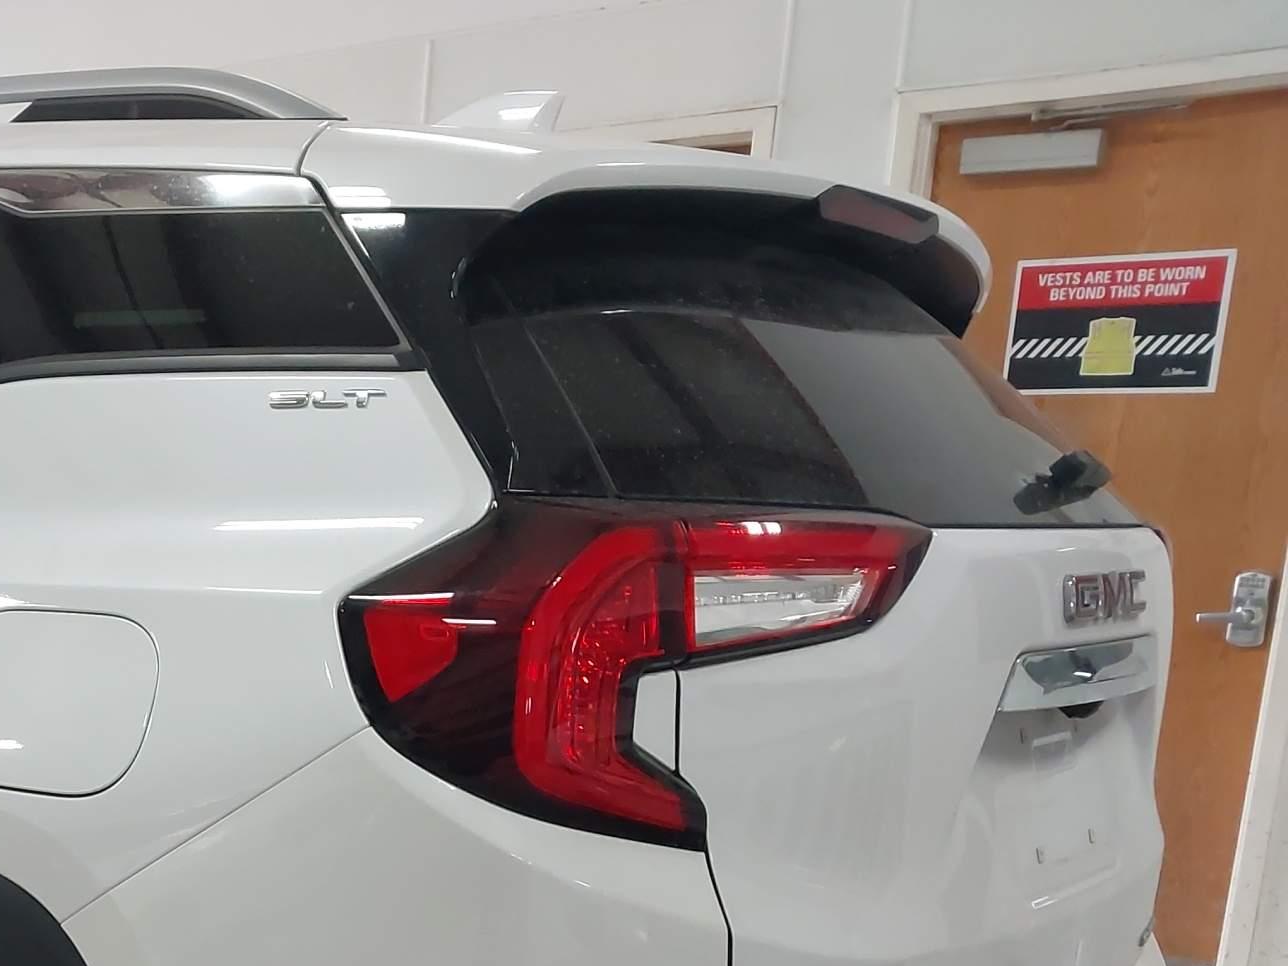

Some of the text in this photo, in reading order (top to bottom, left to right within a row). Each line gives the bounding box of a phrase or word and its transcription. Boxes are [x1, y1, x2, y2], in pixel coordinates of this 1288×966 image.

[1039, 265, 1207, 287] VESTS ARE TO BE WORN
[1049, 281, 1190, 301] BEYOND THIS POINT
[268, 389, 387, 409] SLT
[1063, 568, 1146, 623] GMC
